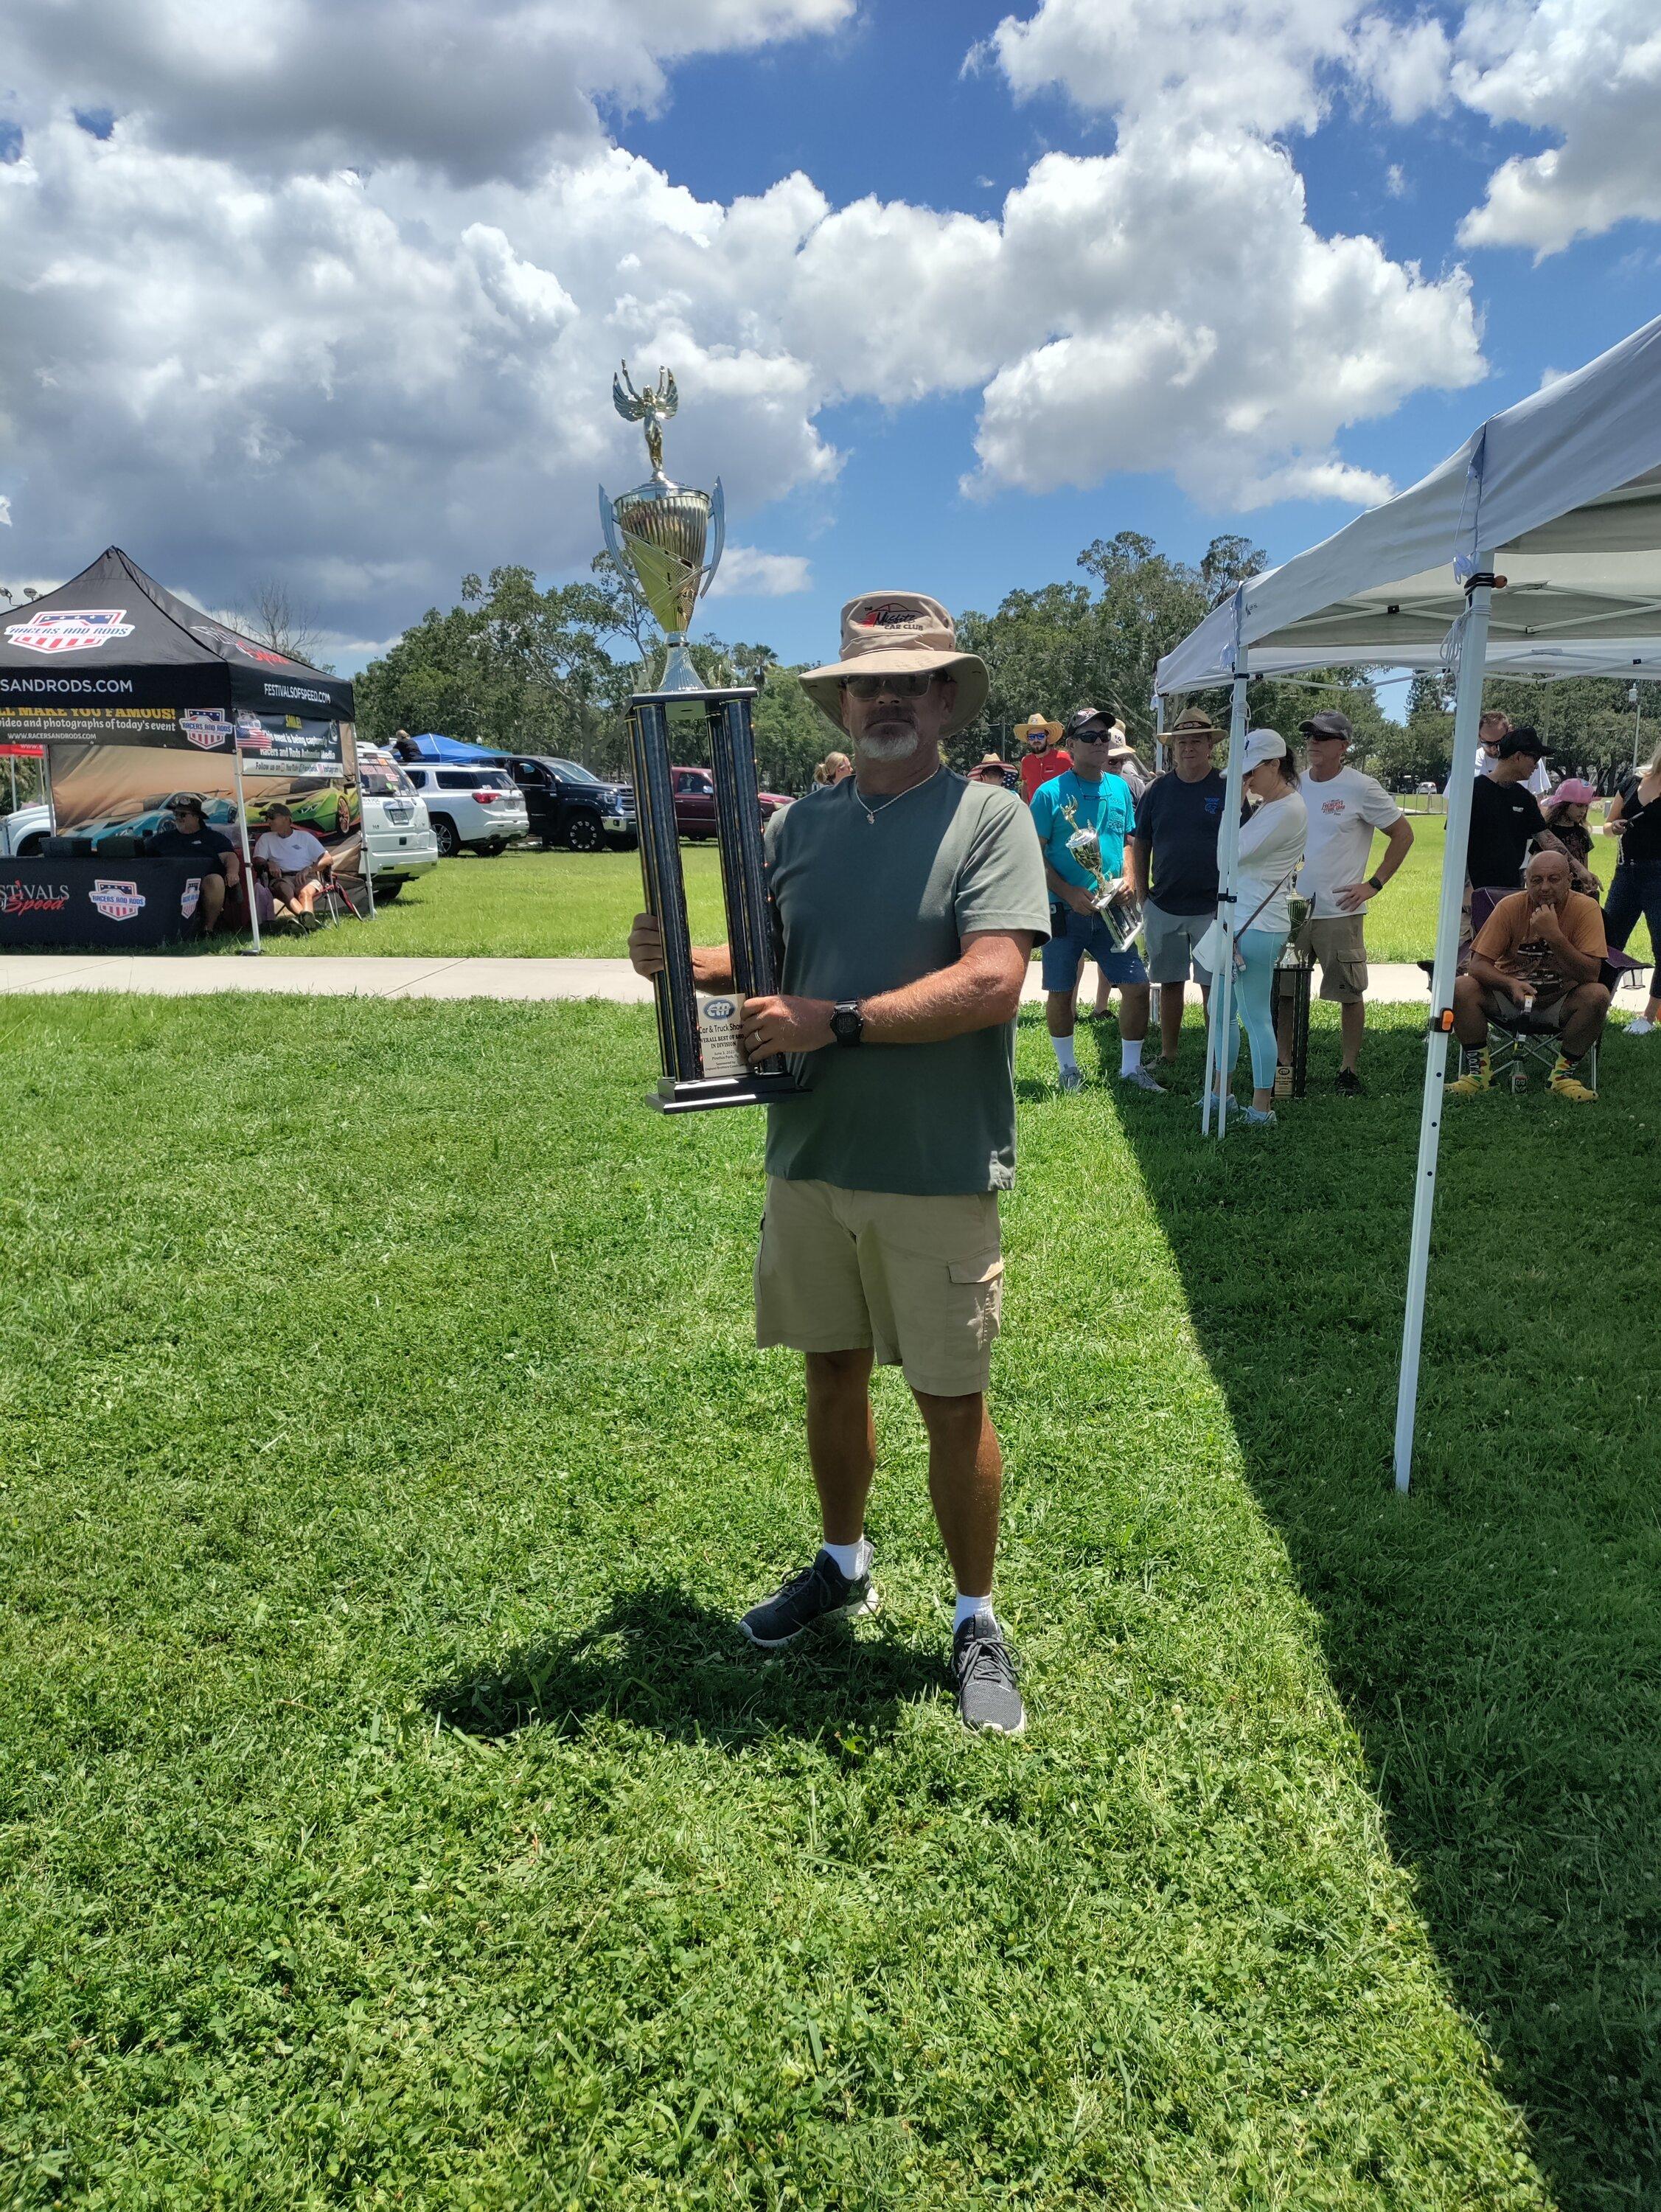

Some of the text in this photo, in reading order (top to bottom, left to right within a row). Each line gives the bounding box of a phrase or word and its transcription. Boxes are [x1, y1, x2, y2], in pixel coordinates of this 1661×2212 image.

[10, 627, 60, 635] RACERS
[93, 627, 129, 636] RODS
[0, 678, 133, 693] SANDRODS.COM
[263, 683, 331, 704] FESTIVALSOFSPEED.COM
[71, 708, 101, 717] YOU
[105, 708, 176, 720] FAMOUS!
[24, 717, 42, 727] and
[43, 717, 104, 730] photographs
[105, 718, 116, 728] of
[116, 719, 150, 731] today's
[150, 722, 176, 731] event
[182, 722, 203, 731] RACERS
[217, 725, 231, 733] RODS
[291, 734, 307, 746] being
[260, 747, 279, 757] Racers
[279, 748, 289, 757] and
[255, 762, 269, 771] Follow
[92, 894, 115, 902] RACERS
[128, 897, 144, 905] RODS
[708, 1025, 714, 1033] &
[714, 1023, 729, 1032] Truck
[717, 1040, 737, 1048] DIVISION
